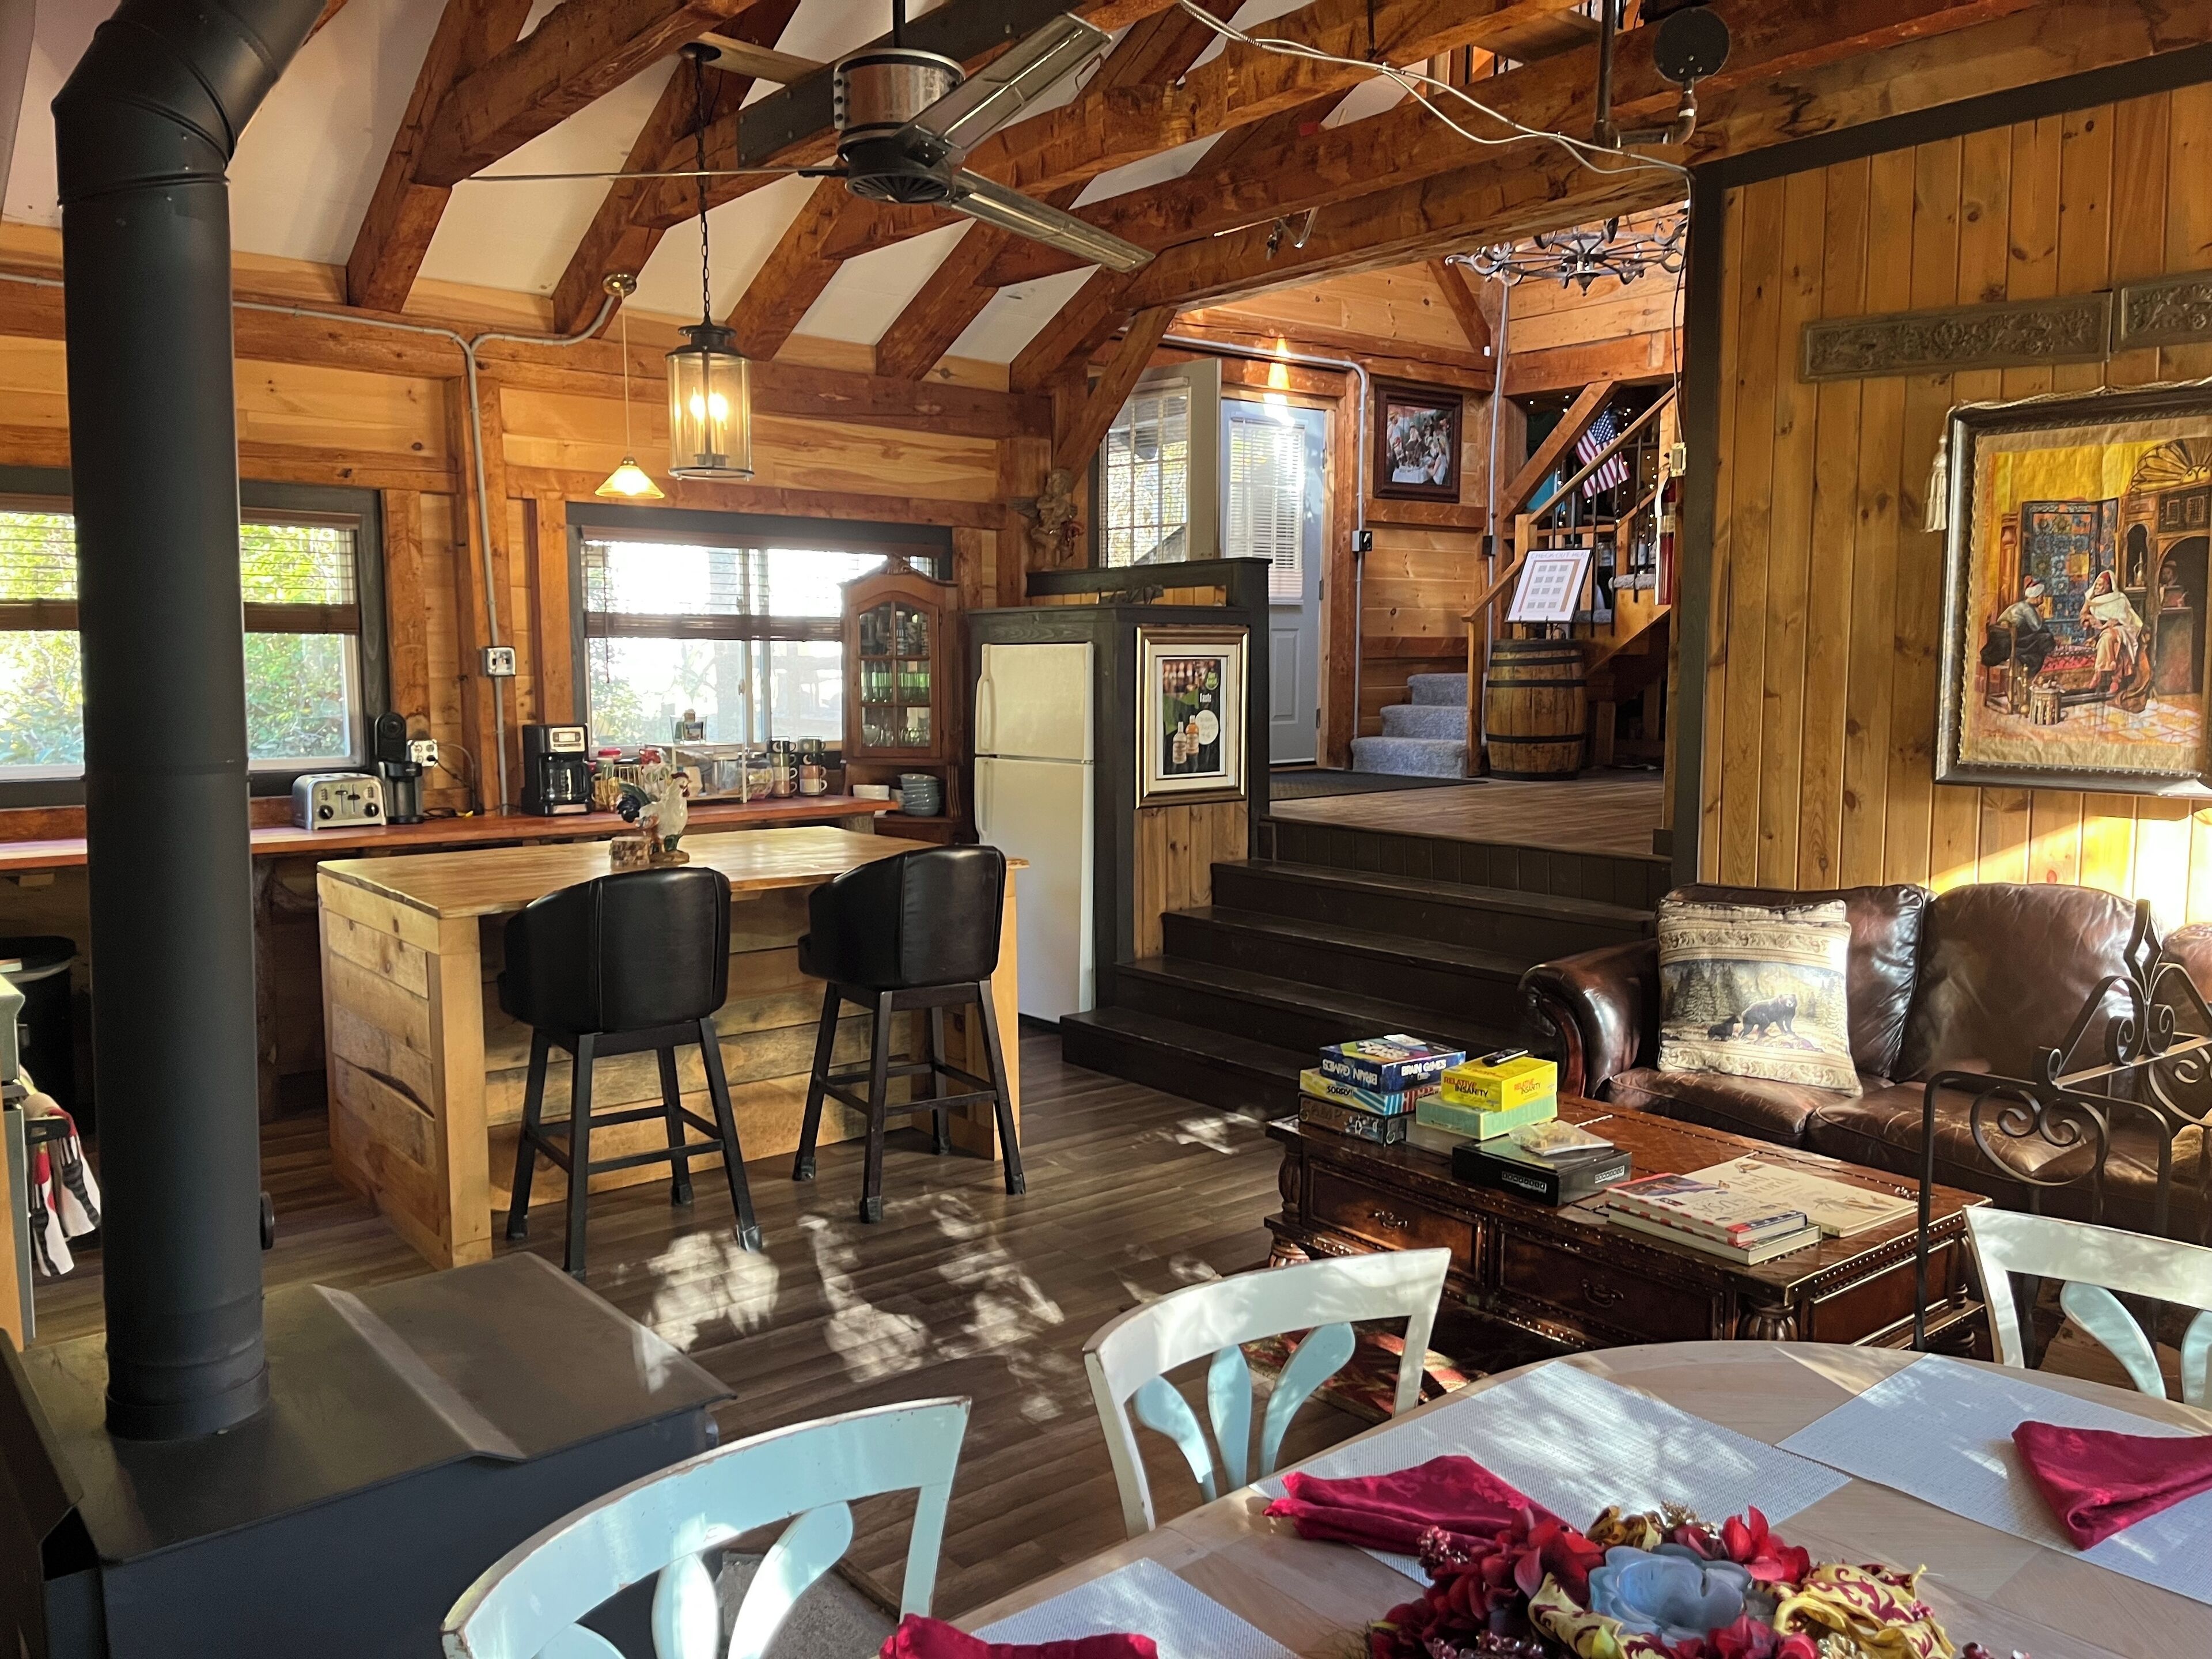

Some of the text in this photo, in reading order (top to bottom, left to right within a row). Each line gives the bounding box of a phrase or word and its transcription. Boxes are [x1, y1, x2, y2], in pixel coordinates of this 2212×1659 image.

[1199, 692, 1211, 703] Taste
[1322, 1059, 1378, 1085] BRAIN GAMES
[1401, 1059, 1446, 1076] BRAIN GAMES
[1444, 1076, 1478, 1088] RELATIVE
[1455, 1084, 1488, 1097] INSANITY
